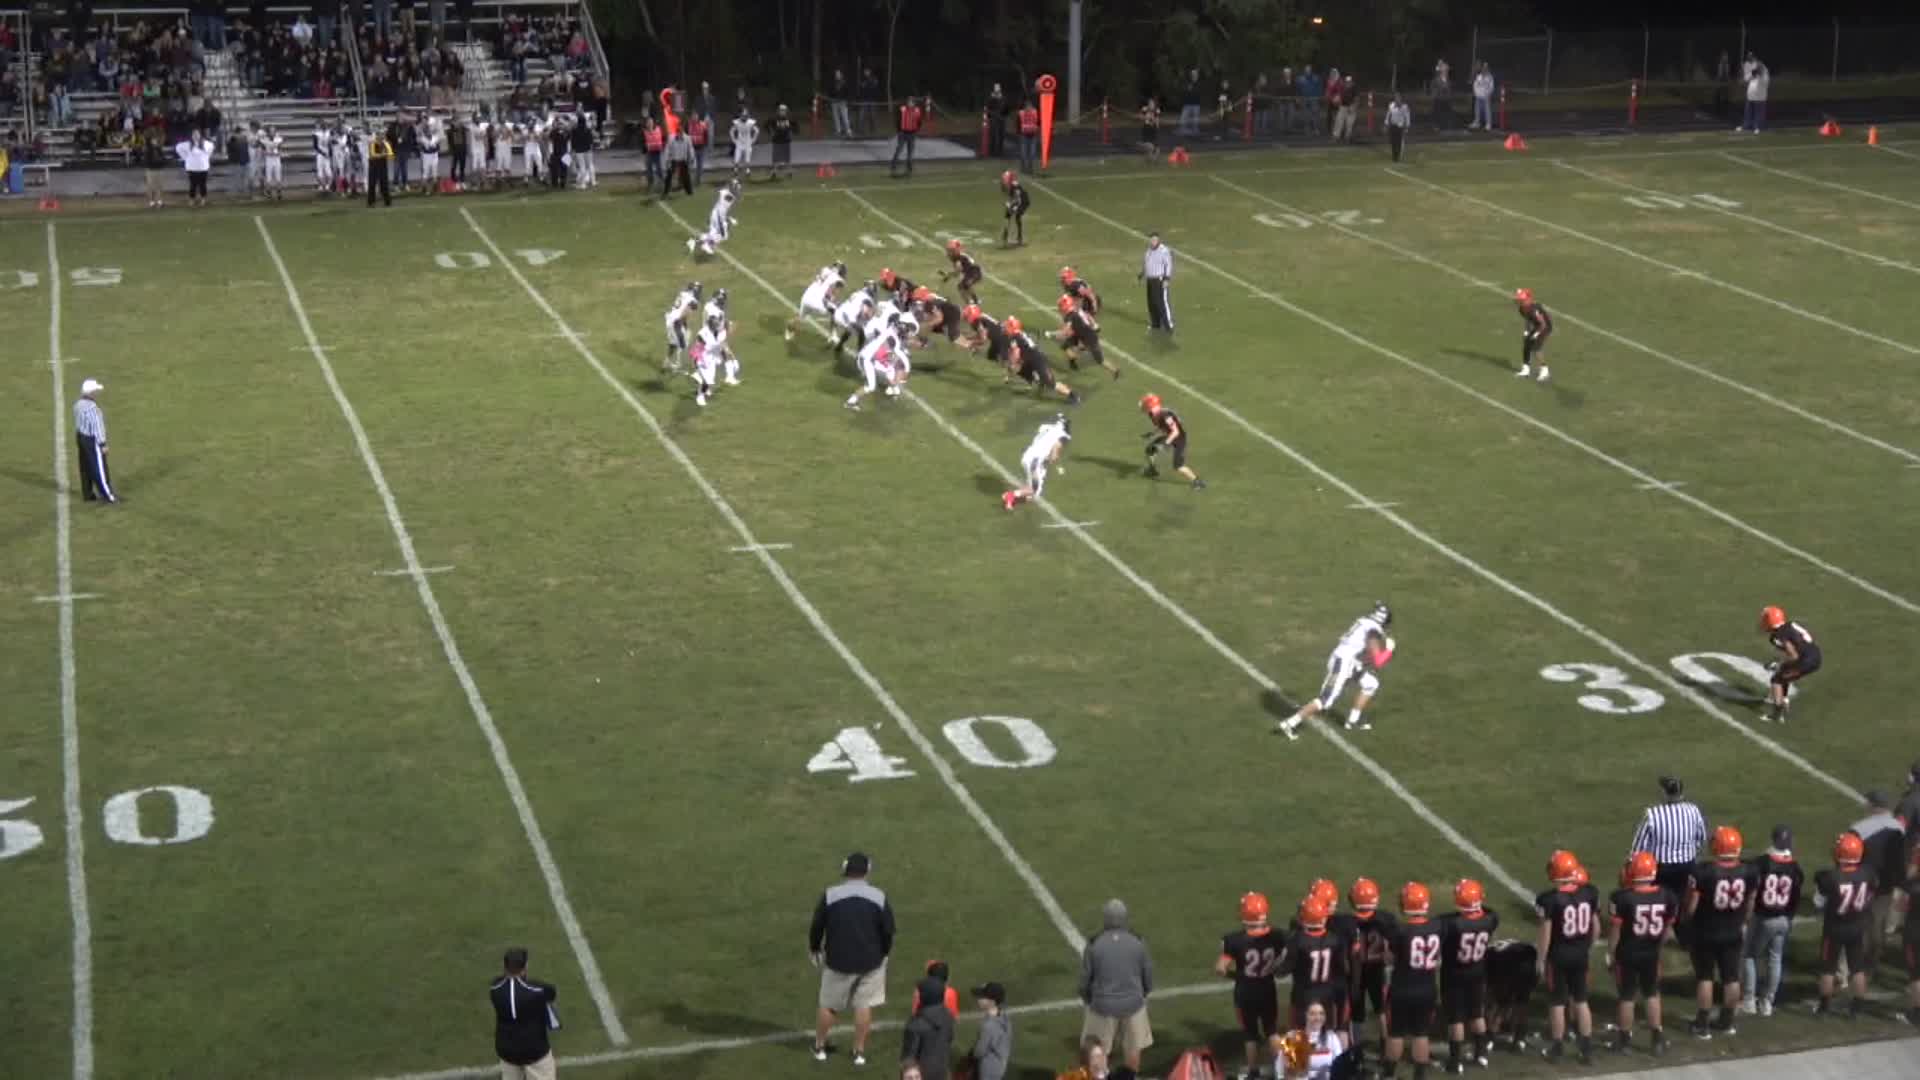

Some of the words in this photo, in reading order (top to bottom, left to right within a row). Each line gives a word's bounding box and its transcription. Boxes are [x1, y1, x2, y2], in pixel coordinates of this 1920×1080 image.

[807, 716, 1057, 783] 40
[1714, 878, 1746, 910] 63
[1762, 873, 1793, 906] 83
[1839, 881, 1870, 915] 74
[1563, 902, 1592, 936] 80
[1633, 904, 1665, 936] 55
[1409, 933, 1441, 970] 62
[1458, 931, 1489, 963] 56
[1309, 947, 1332, 983] 11
